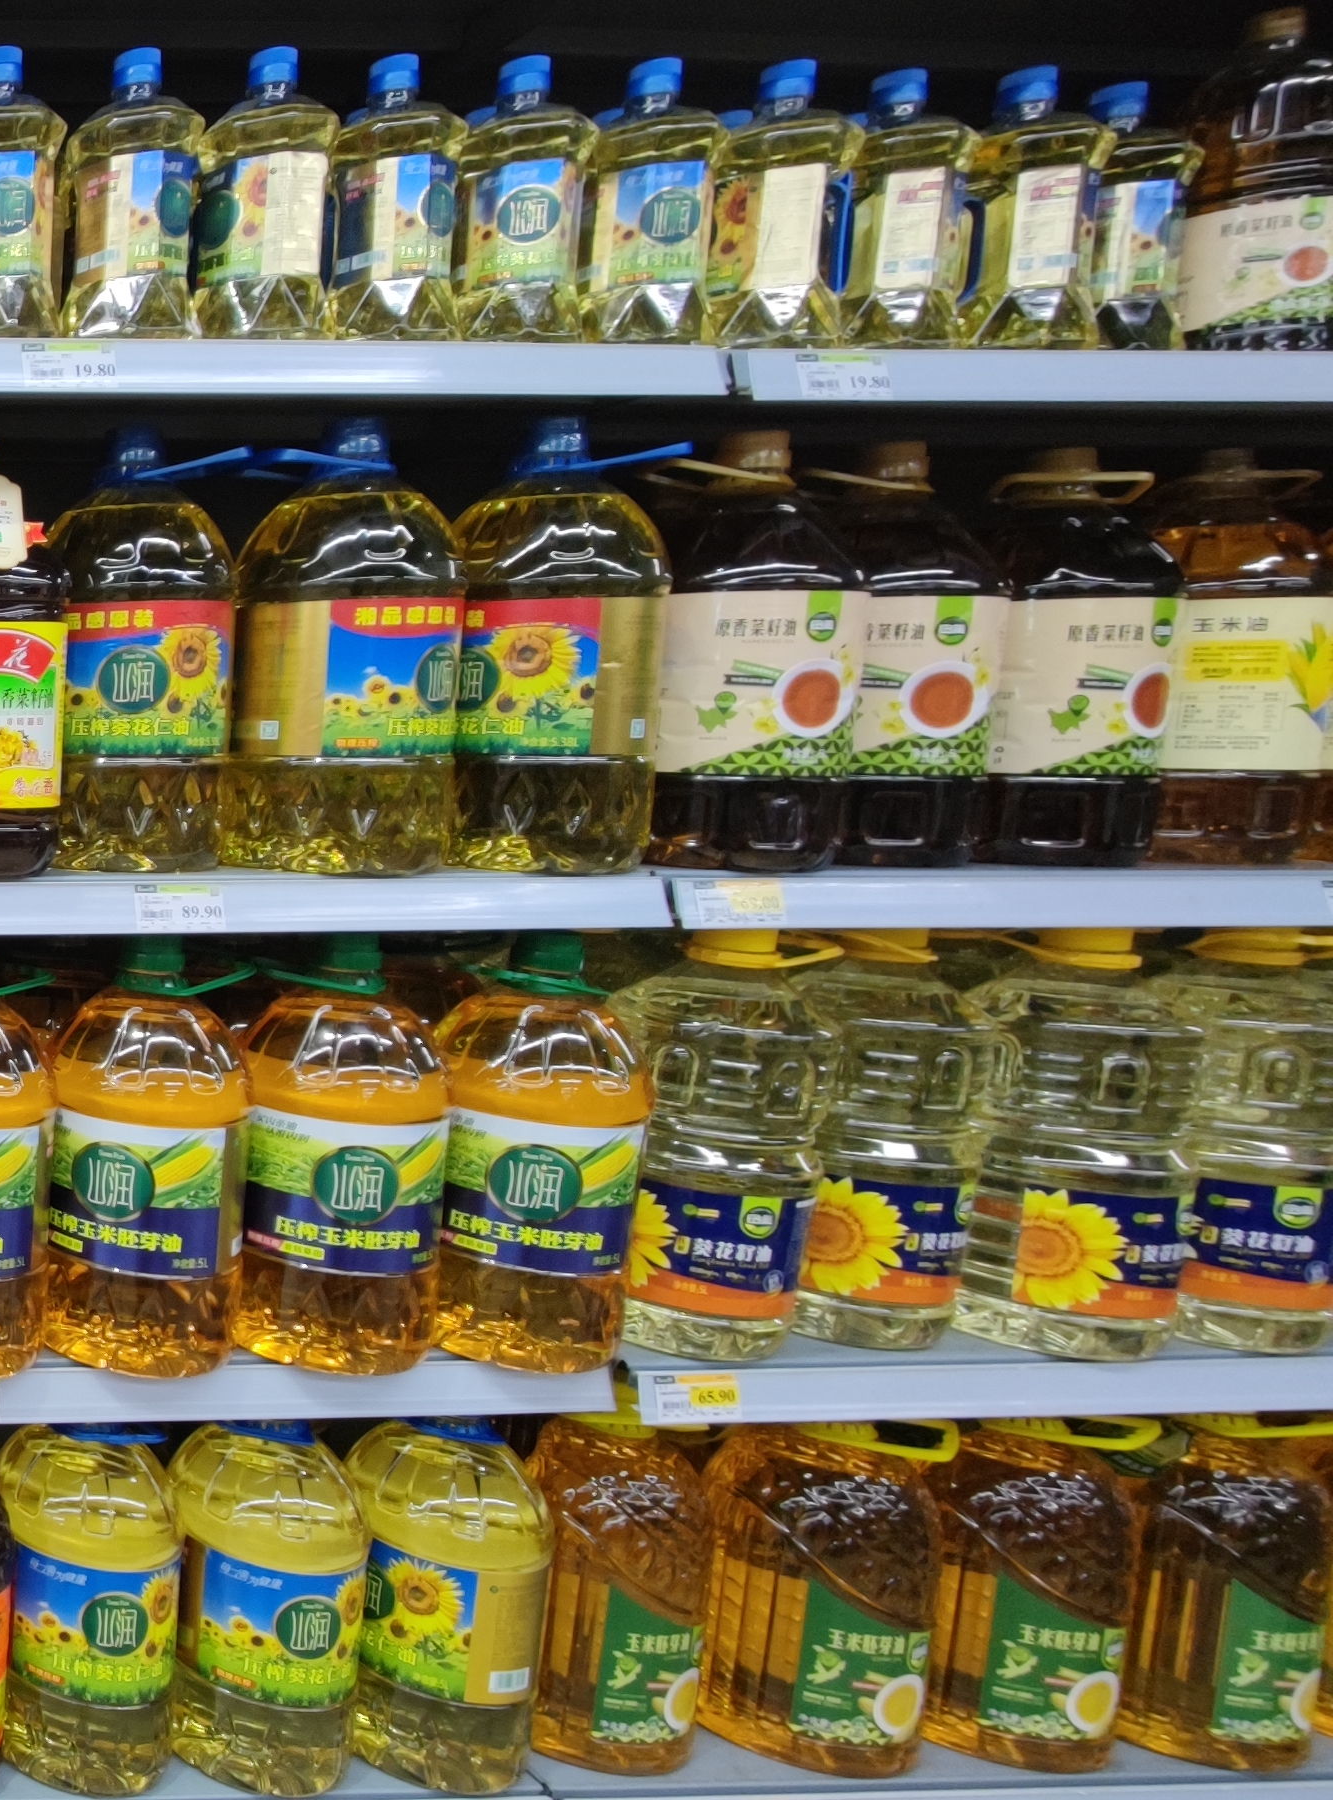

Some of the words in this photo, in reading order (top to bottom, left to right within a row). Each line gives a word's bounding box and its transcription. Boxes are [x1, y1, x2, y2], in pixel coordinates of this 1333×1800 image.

[75, 362, 116, 377] 19.80
[849, 376, 890, 389] 19.80
[715, 618, 796, 637] 原香菜籽油
[1067, 623, 1145, 643] 原香菜籽油
[1192, 617, 1269, 632] 玉米油
[112, 662, 155, 703] 山润
[71, 718, 191, 737] 压榨葵花仁油
[182, 905, 222, 918] 89.90
[88, 1157, 134, 1210] 山润
[331, 1161, 384, 1212] 山润
[507, 1160, 564, 1211] 山润
[50, 1208, 182, 1253] 压榨玉米胚芽油
[274, 1215, 421, 1250] 压榨玉米胚芽油
[449, 1209, 604, 1252] 压榨玉米胚芽油
[699, 1388, 735, 1402] 65.90
[96, 1606, 136, 1649] 山润
[290, 1610, 330, 1651] 山润
[52, 1656, 163, 1683] 压榨葵花仁油
